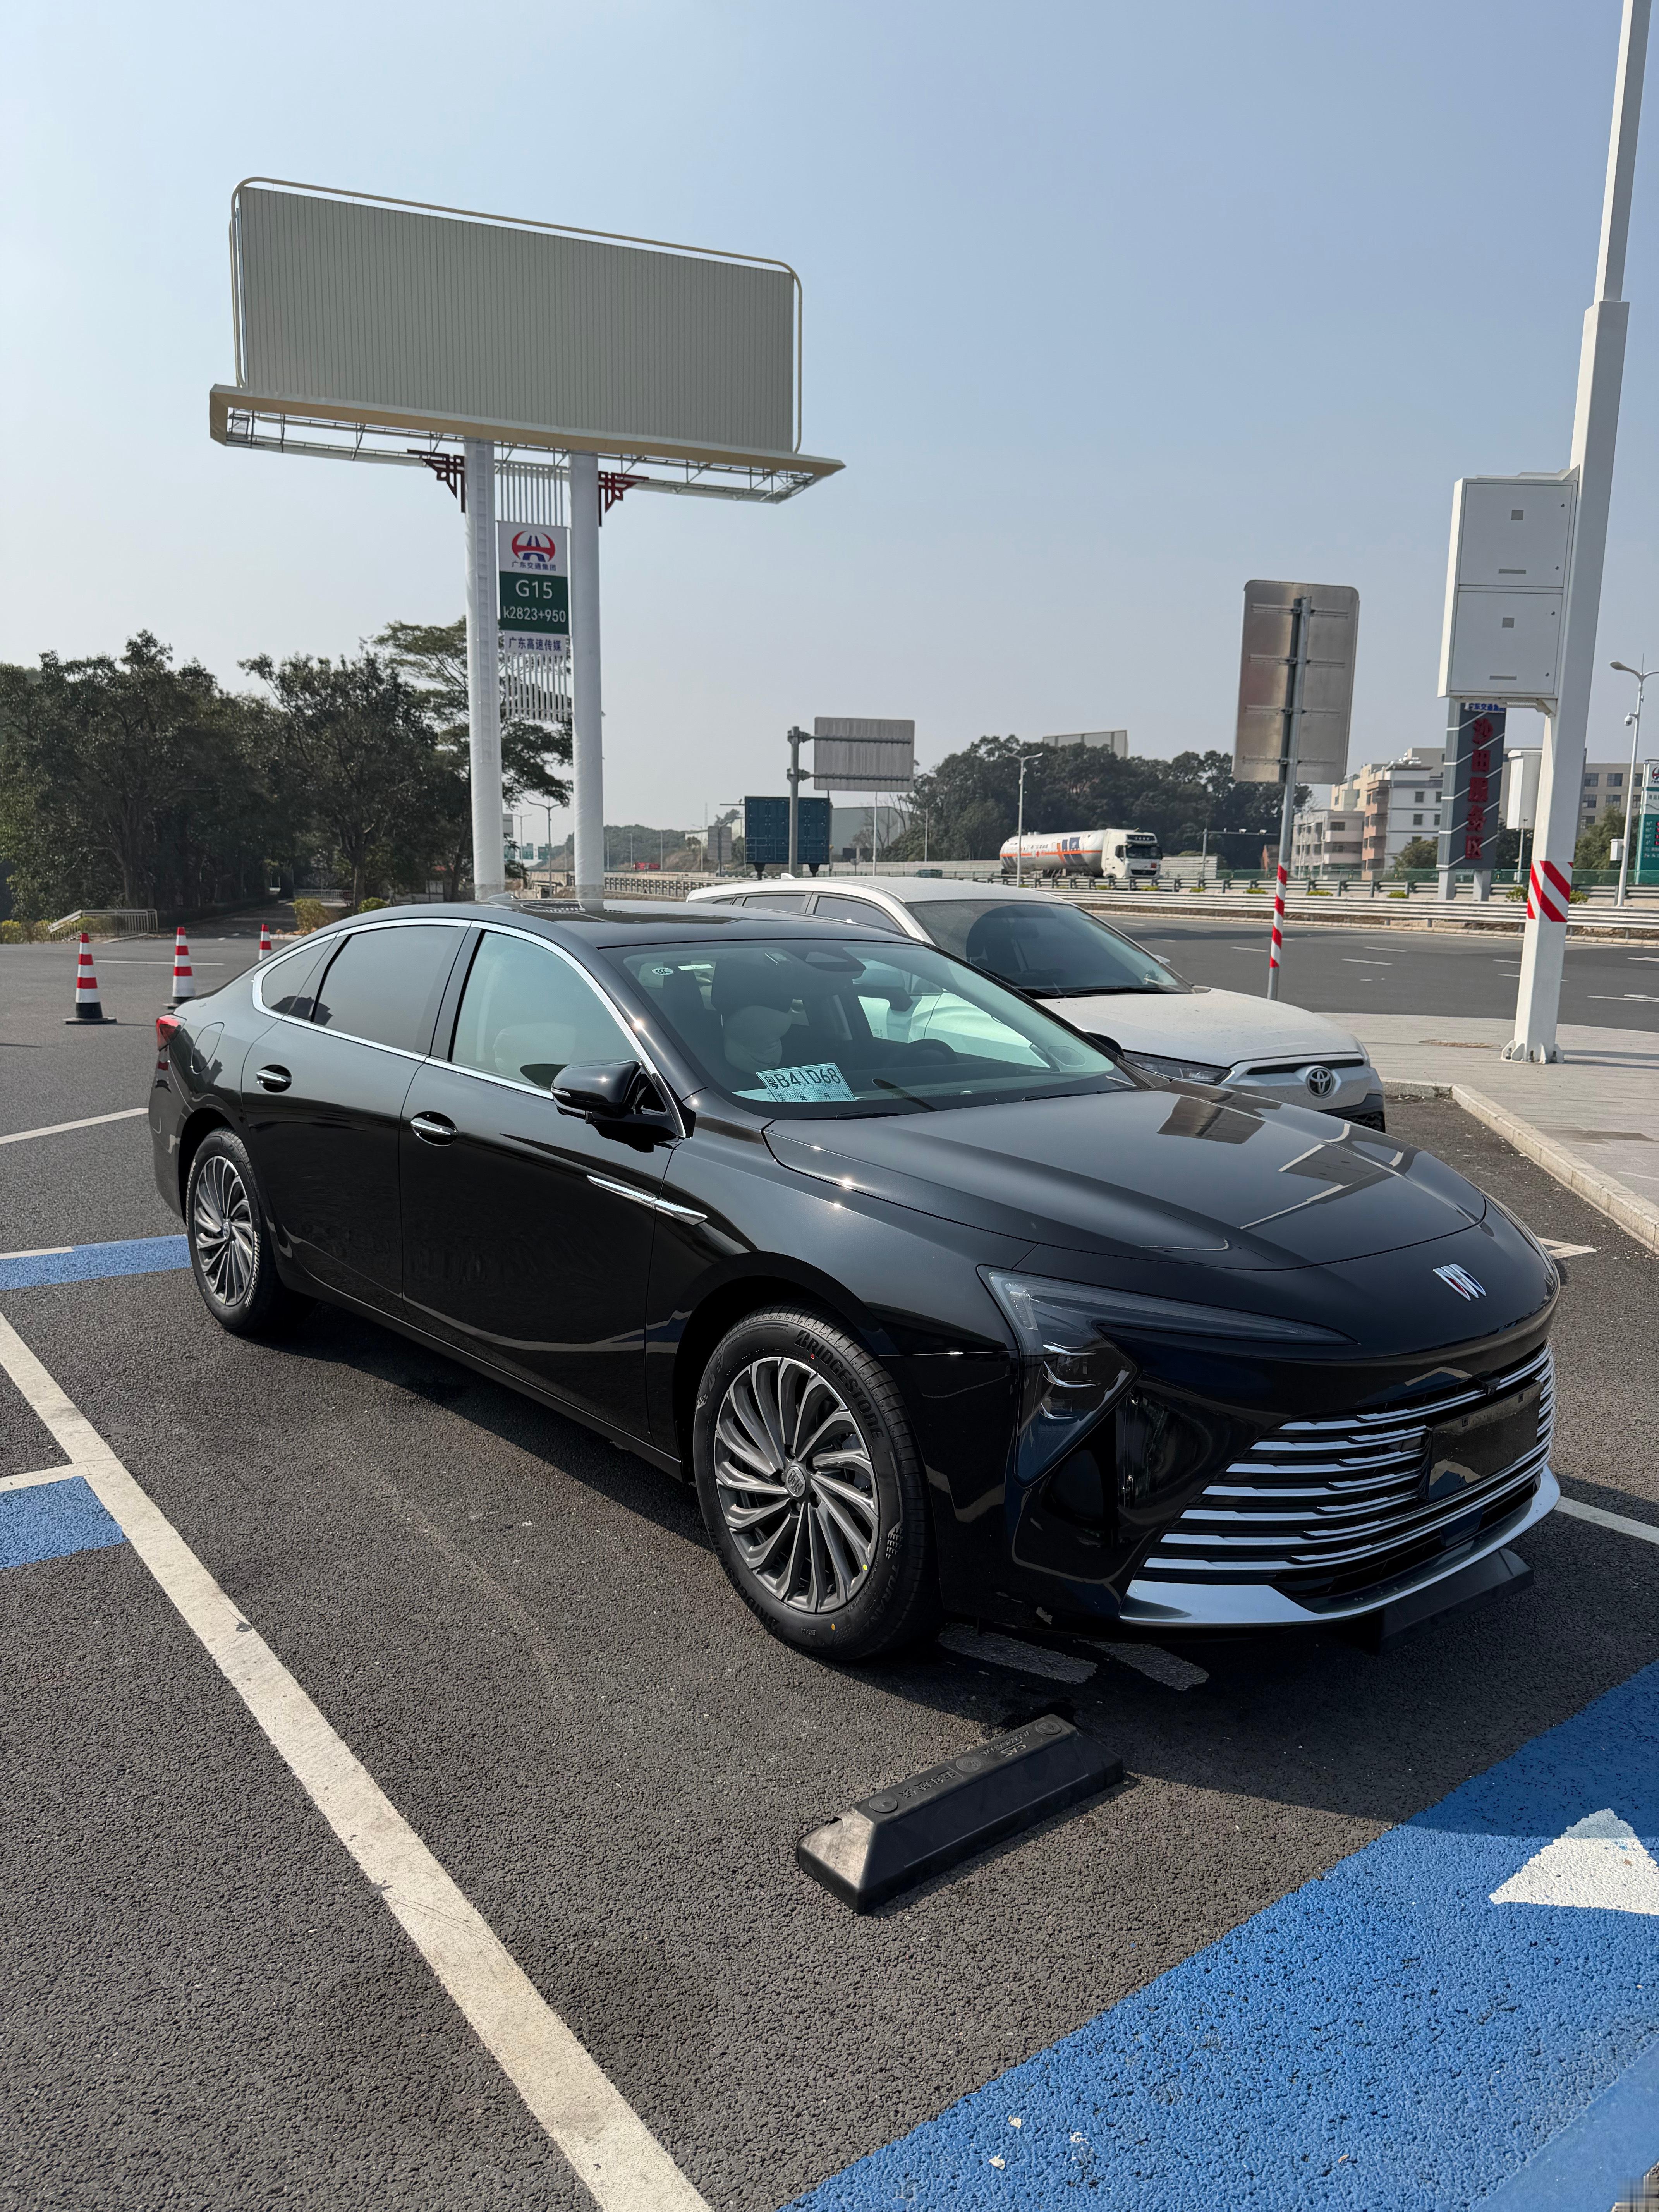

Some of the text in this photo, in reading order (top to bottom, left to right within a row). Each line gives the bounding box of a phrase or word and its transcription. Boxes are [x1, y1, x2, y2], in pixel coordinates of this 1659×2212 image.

[512, 561, 556, 571] 广东交通集团
[516, 580, 553, 599] G15
[504, 606, 566, 623] k2823+950
[508, 637, 562, 651] 广东高速传媒
[794, 1330, 885, 1440] BRIDGESTONE
[898, 1769, 956, 1799] 五年质保
